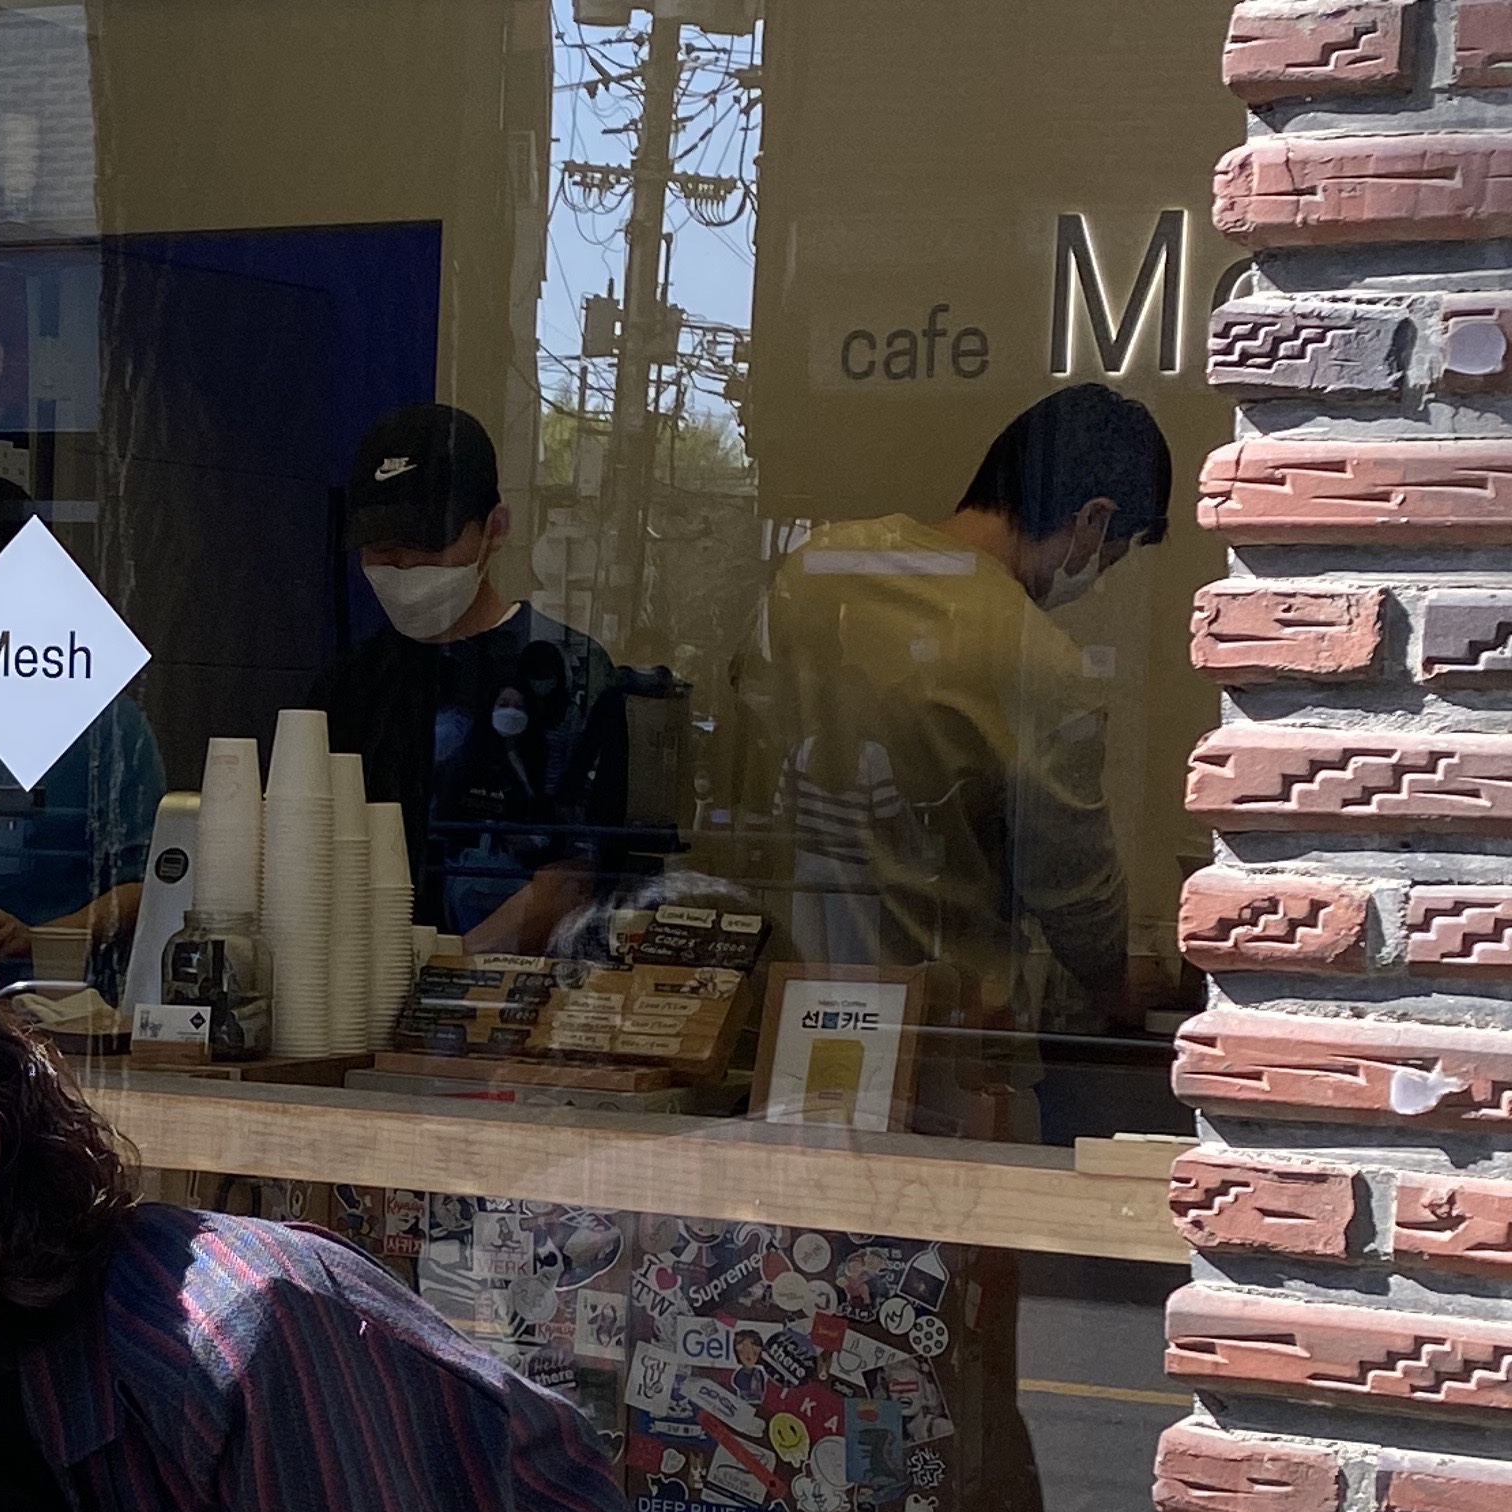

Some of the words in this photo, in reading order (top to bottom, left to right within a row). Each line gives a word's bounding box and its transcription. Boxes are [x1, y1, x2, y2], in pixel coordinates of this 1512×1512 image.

[841, 303, 989, 380] cafe
[632, 1279, 675, 1317] TW
[689, 1253, 762, 1308] Supreme
